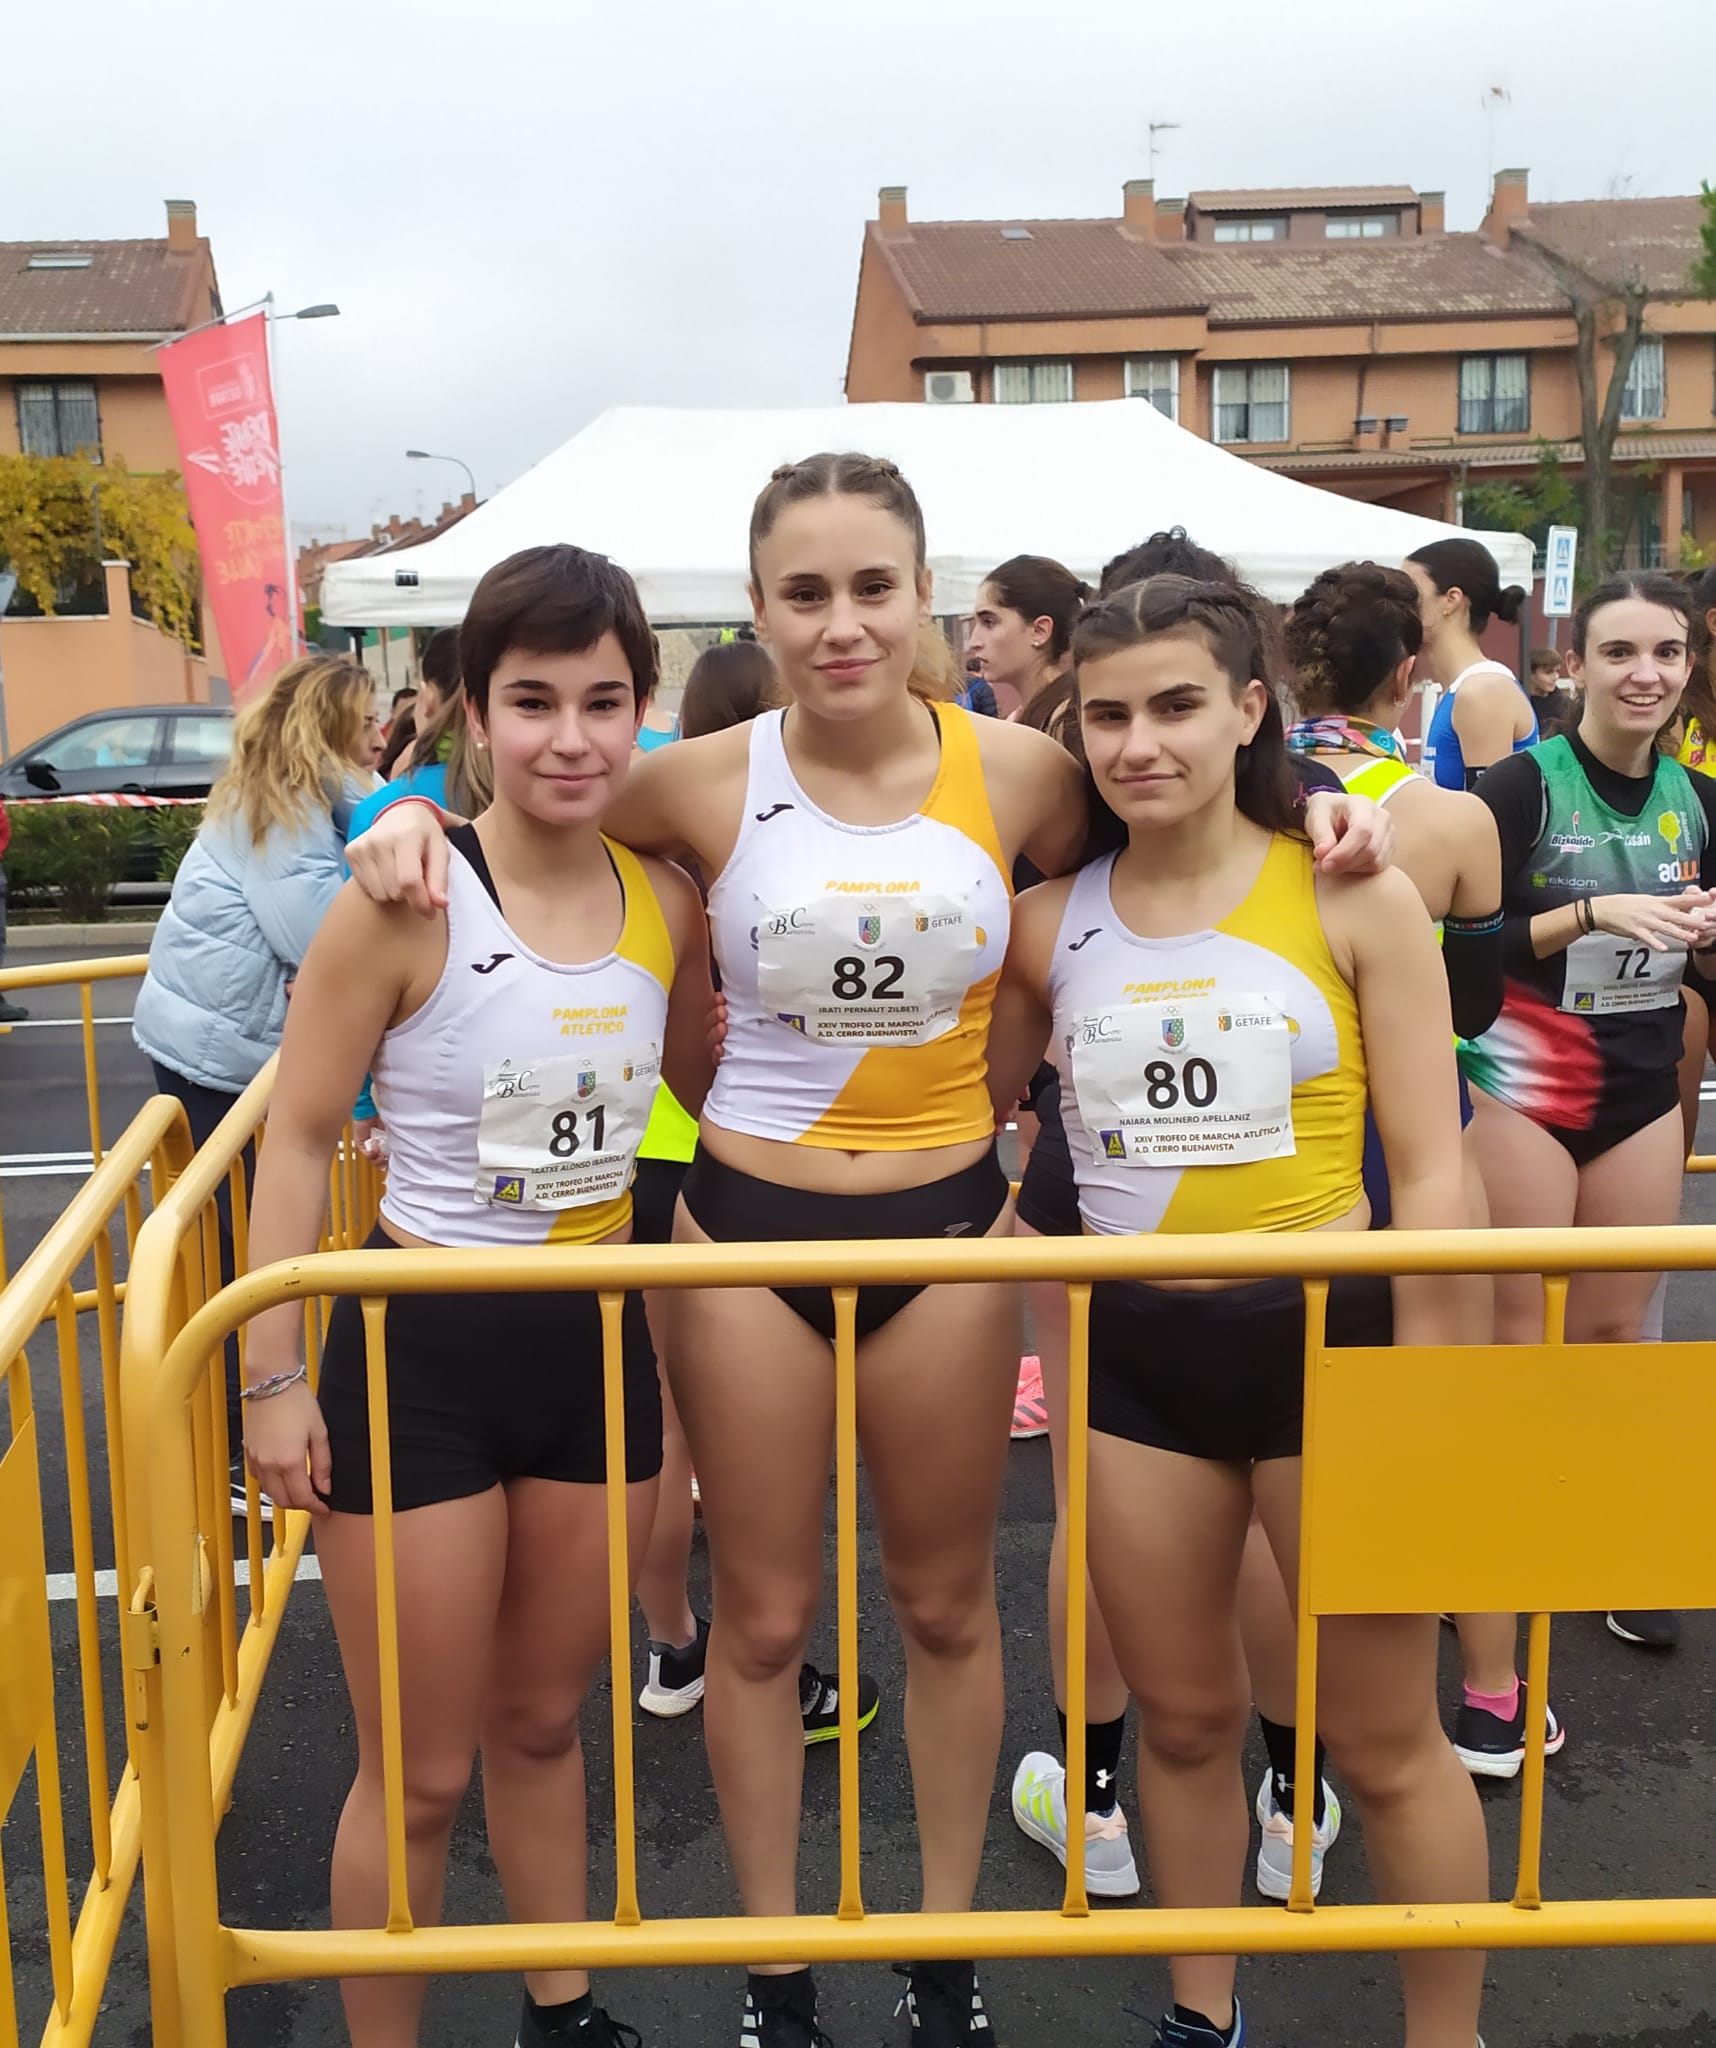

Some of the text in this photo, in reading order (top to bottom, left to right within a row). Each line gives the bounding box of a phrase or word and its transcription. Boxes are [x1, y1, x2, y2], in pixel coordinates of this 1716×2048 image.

[825, 880, 921, 893] PAMPLONA
[931, 915, 962, 928] GETAFE
[1614, 947, 1651, 980] 72
[831, 955, 905, 1001] 82
[1122, 976, 1216, 995] PAMPLONA
[552, 1004, 628, 1020] PAMPLONA
[819, 1006, 842, 1014] IRATI
[843, 1006, 886, 1014] PERNAUT
[839, 1021, 873, 1029] TROFEO
[887, 1020, 925, 1028] MARCHA
[1235, 1016, 1272, 1027] GETAFE
[1143, 1057, 1218, 1110] 80
[1119, 1113, 1251, 1126] NAIARA MOLINERO APELLANIZ
[549, 1104, 606, 1158] 81
[1134, 1135, 1153, 1143] XXIV
[1155, 1134, 1187, 1142] TROFEO
[1202, 1132, 1240, 1140] MARCHA
[1243, 1126, 1281, 1139] ATLÉTICA
[1153, 1145, 1179, 1153] CERRO
[1181, 1143, 1235, 1152] BUENAVISTA
[560, 1160, 591, 1172] ALONSO
[592, 1154, 626, 1167] IBARROLA
[536, 1170, 624, 1191] XXIV TROFEO DE MARCHA
[535, 1181, 617, 1200] A.D. CERRO BUENAVISTA
